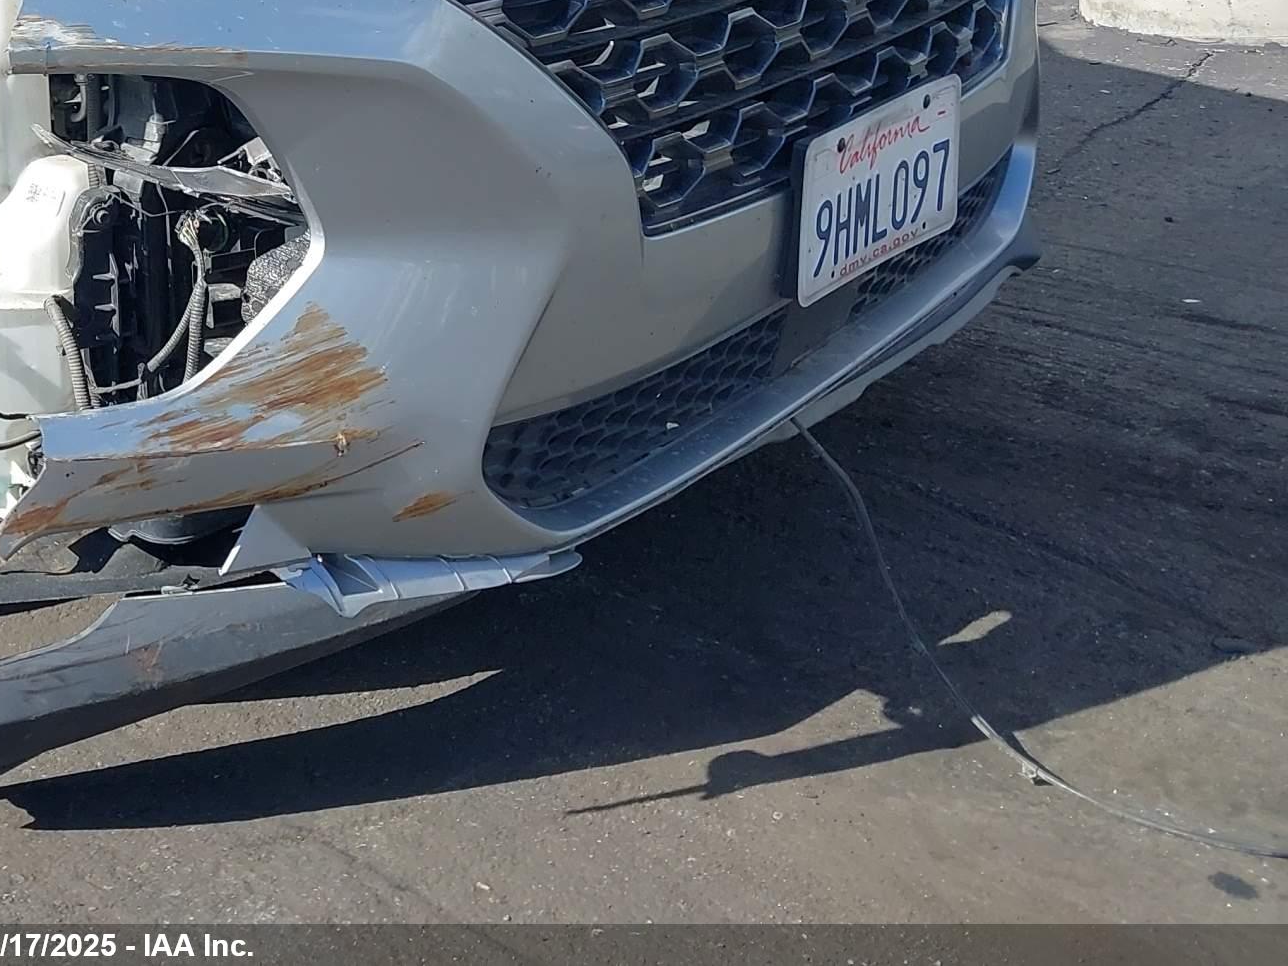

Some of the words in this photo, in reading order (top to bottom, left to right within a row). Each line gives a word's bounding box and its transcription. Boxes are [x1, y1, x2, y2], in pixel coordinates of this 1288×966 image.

[839, 115, 930, 174] California
[813, 138, 951, 278] 9HML097
[839, 228, 919, 278] dmv.ca.gov
